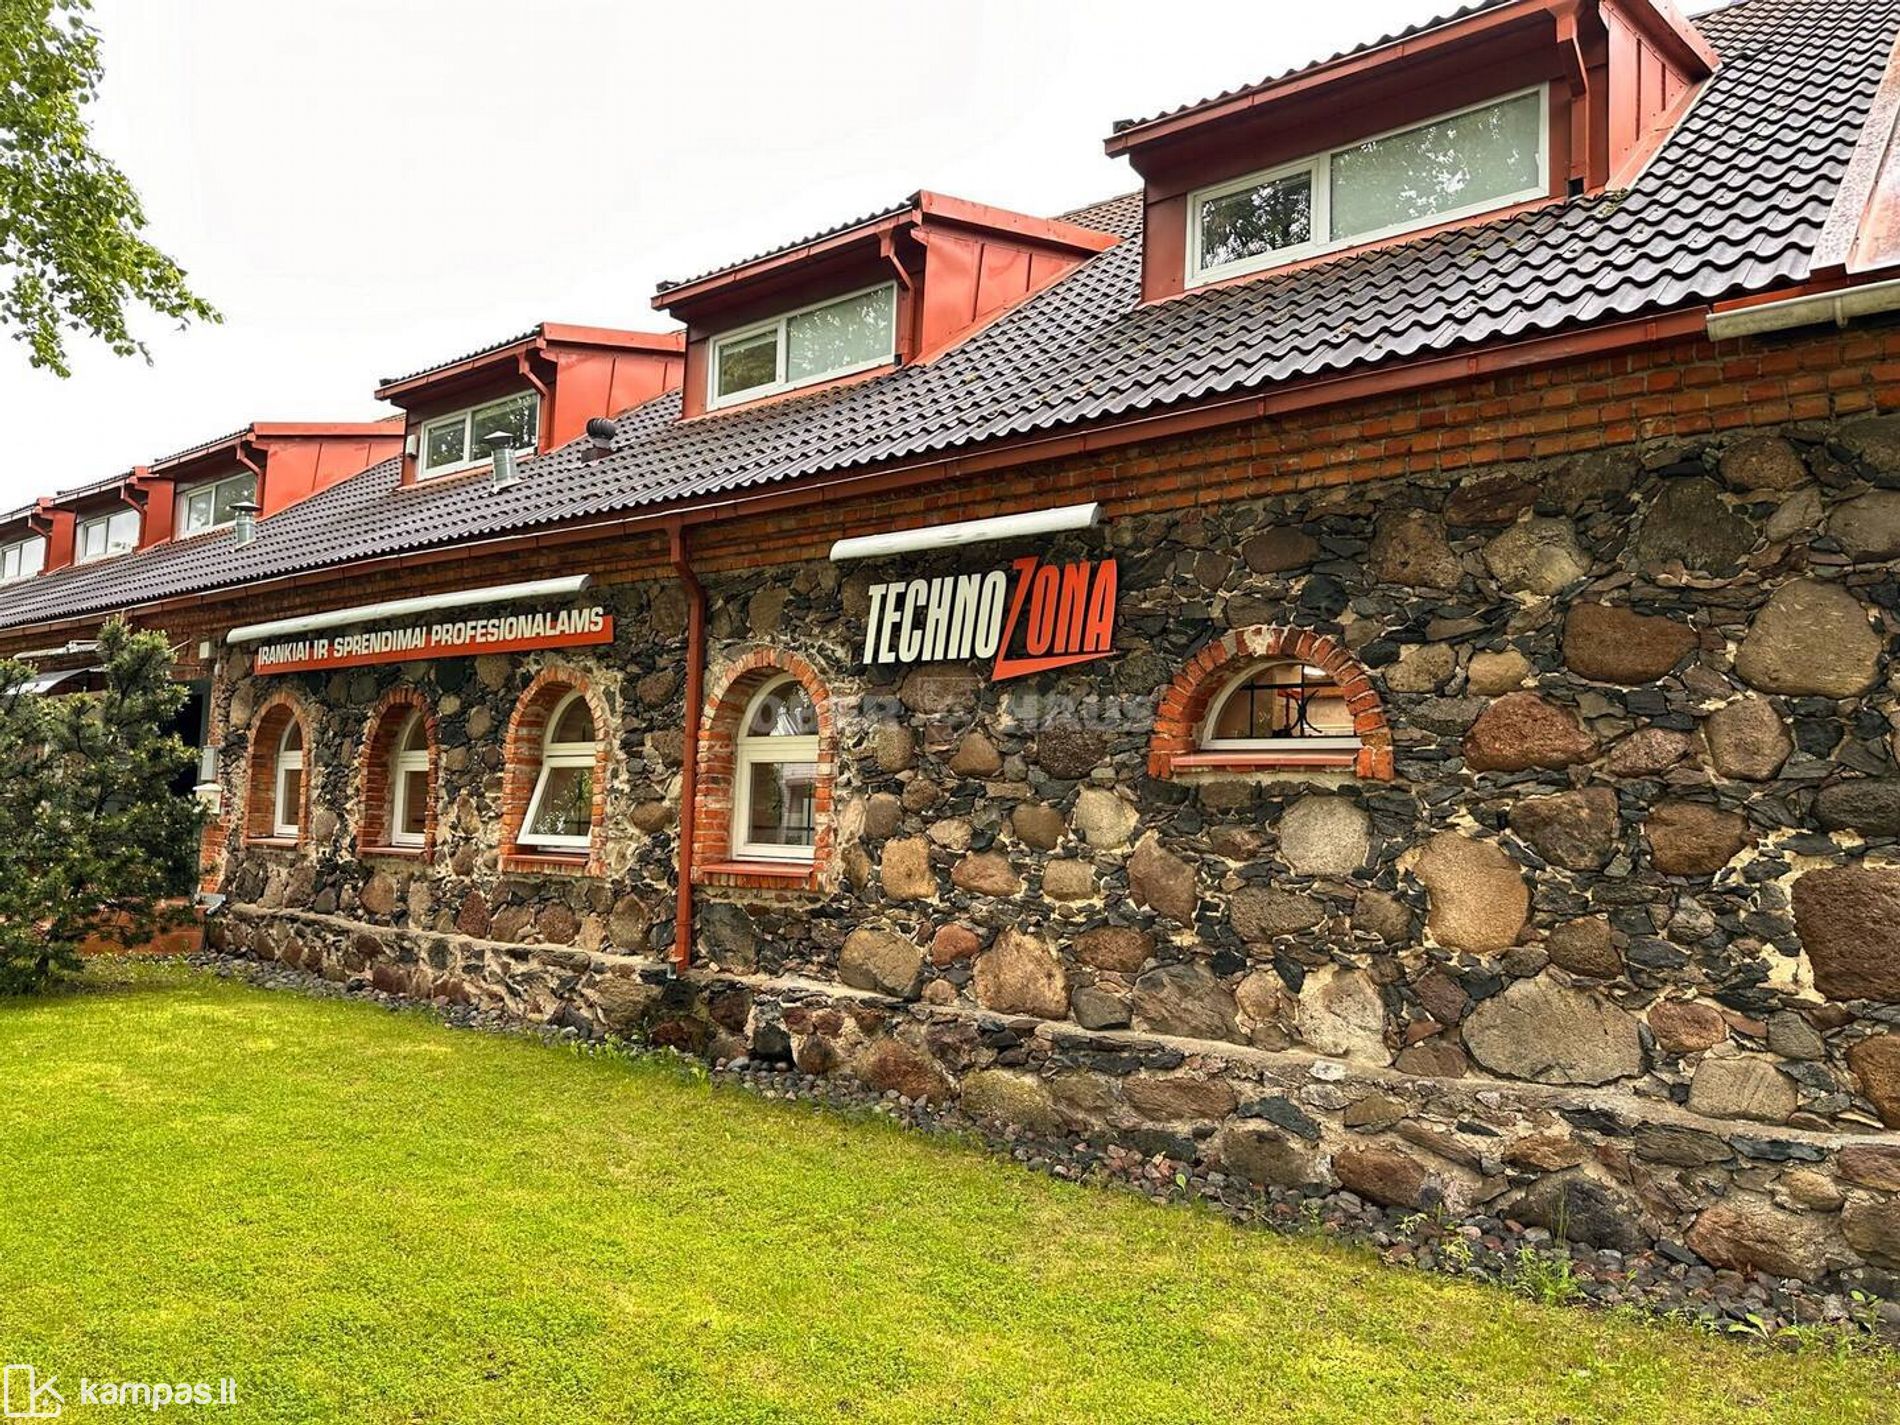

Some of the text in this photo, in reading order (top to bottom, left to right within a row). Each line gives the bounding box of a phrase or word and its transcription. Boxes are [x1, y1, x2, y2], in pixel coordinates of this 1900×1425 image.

[314, 639, 328, 660] IR
[333, 627, 425, 657] SPRENDIMAI
[431, 607, 604, 647] PROFESIONALAMS
[863, 556, 1117, 681] TECHNOZONA
